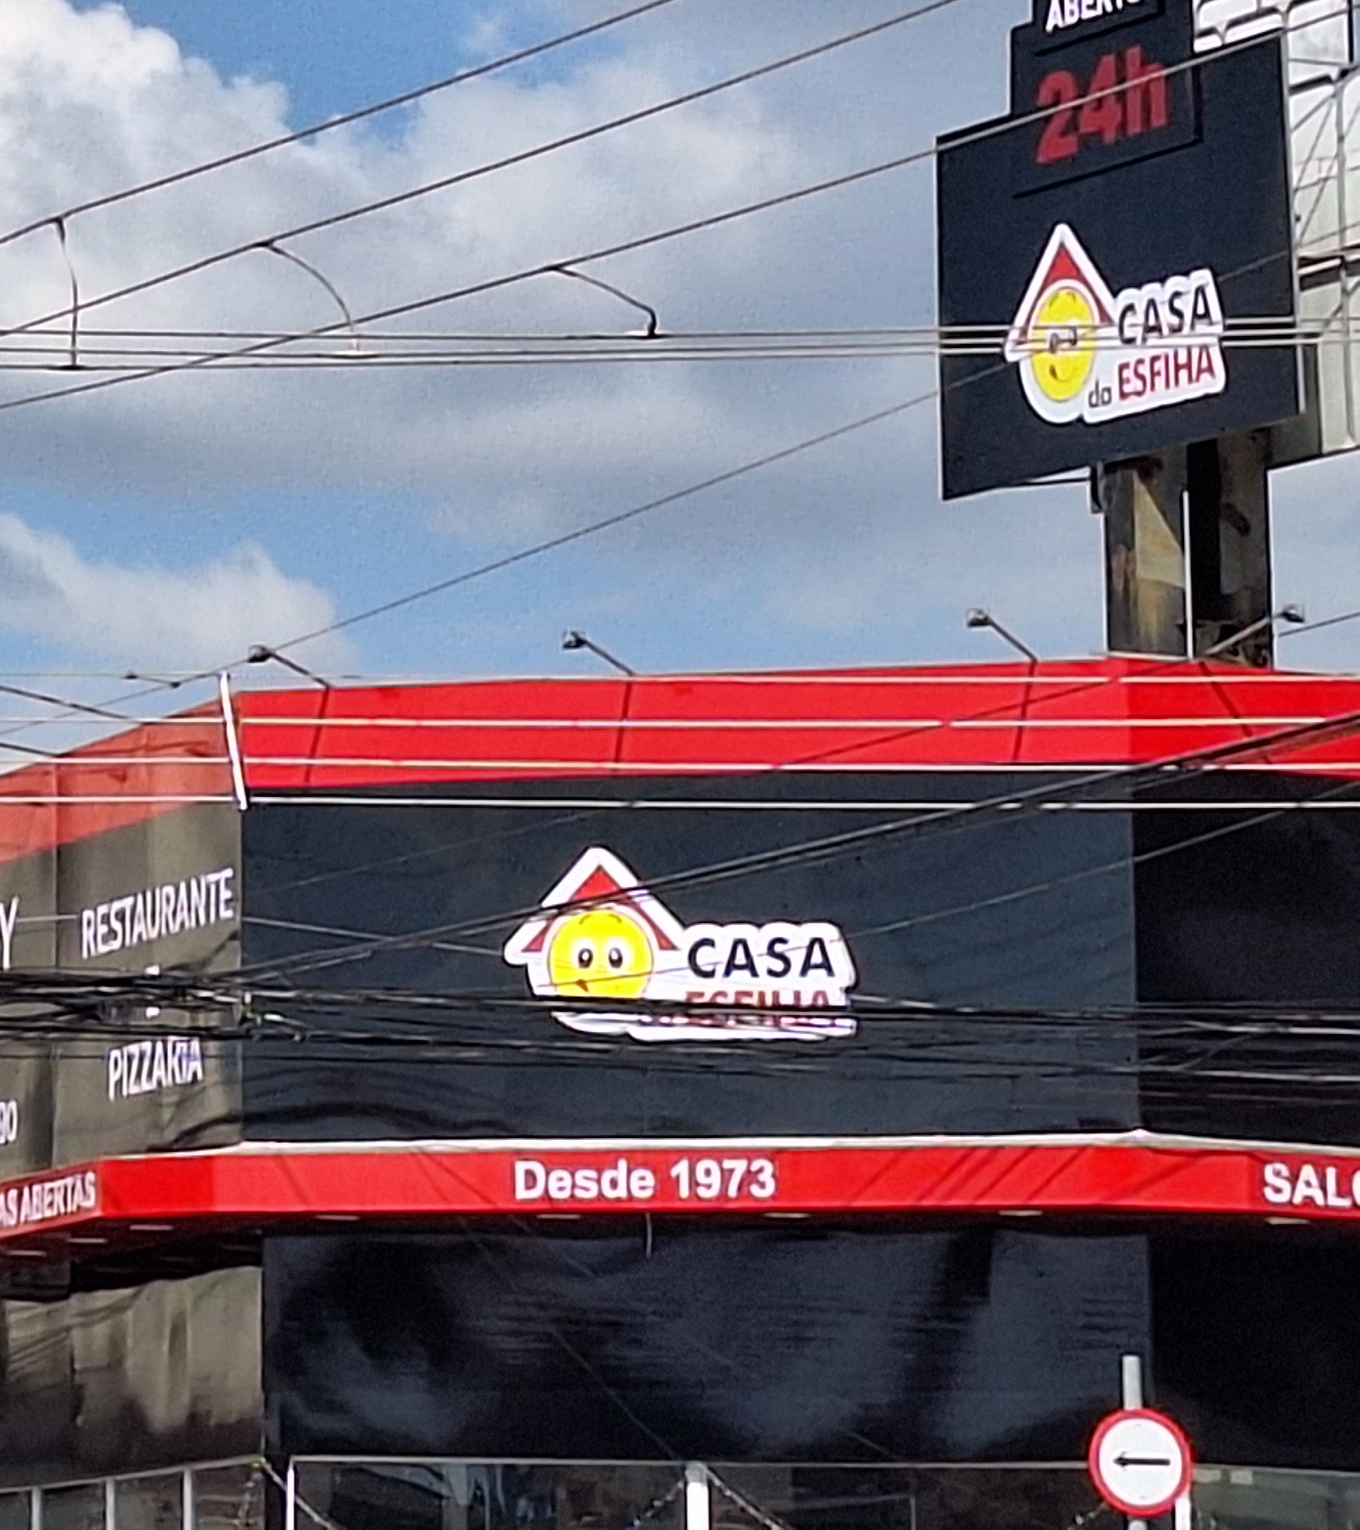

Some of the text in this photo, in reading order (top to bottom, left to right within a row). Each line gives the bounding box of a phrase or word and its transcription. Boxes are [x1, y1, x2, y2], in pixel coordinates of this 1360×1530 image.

[1037, 46, 1167, 163] 24h
[1118, 284, 1215, 344] CASA
[1118, 345, 1216, 401] ESFIHA
[82, 868, 233, 958] RESTAURANTE
[688, 938, 836, 978] CASA
[108, 1035, 203, 1102] PIZZARIA
[20, 1171, 96, 1223] ABERTAS
[514, 1158, 776, 1200] Desde 1973
